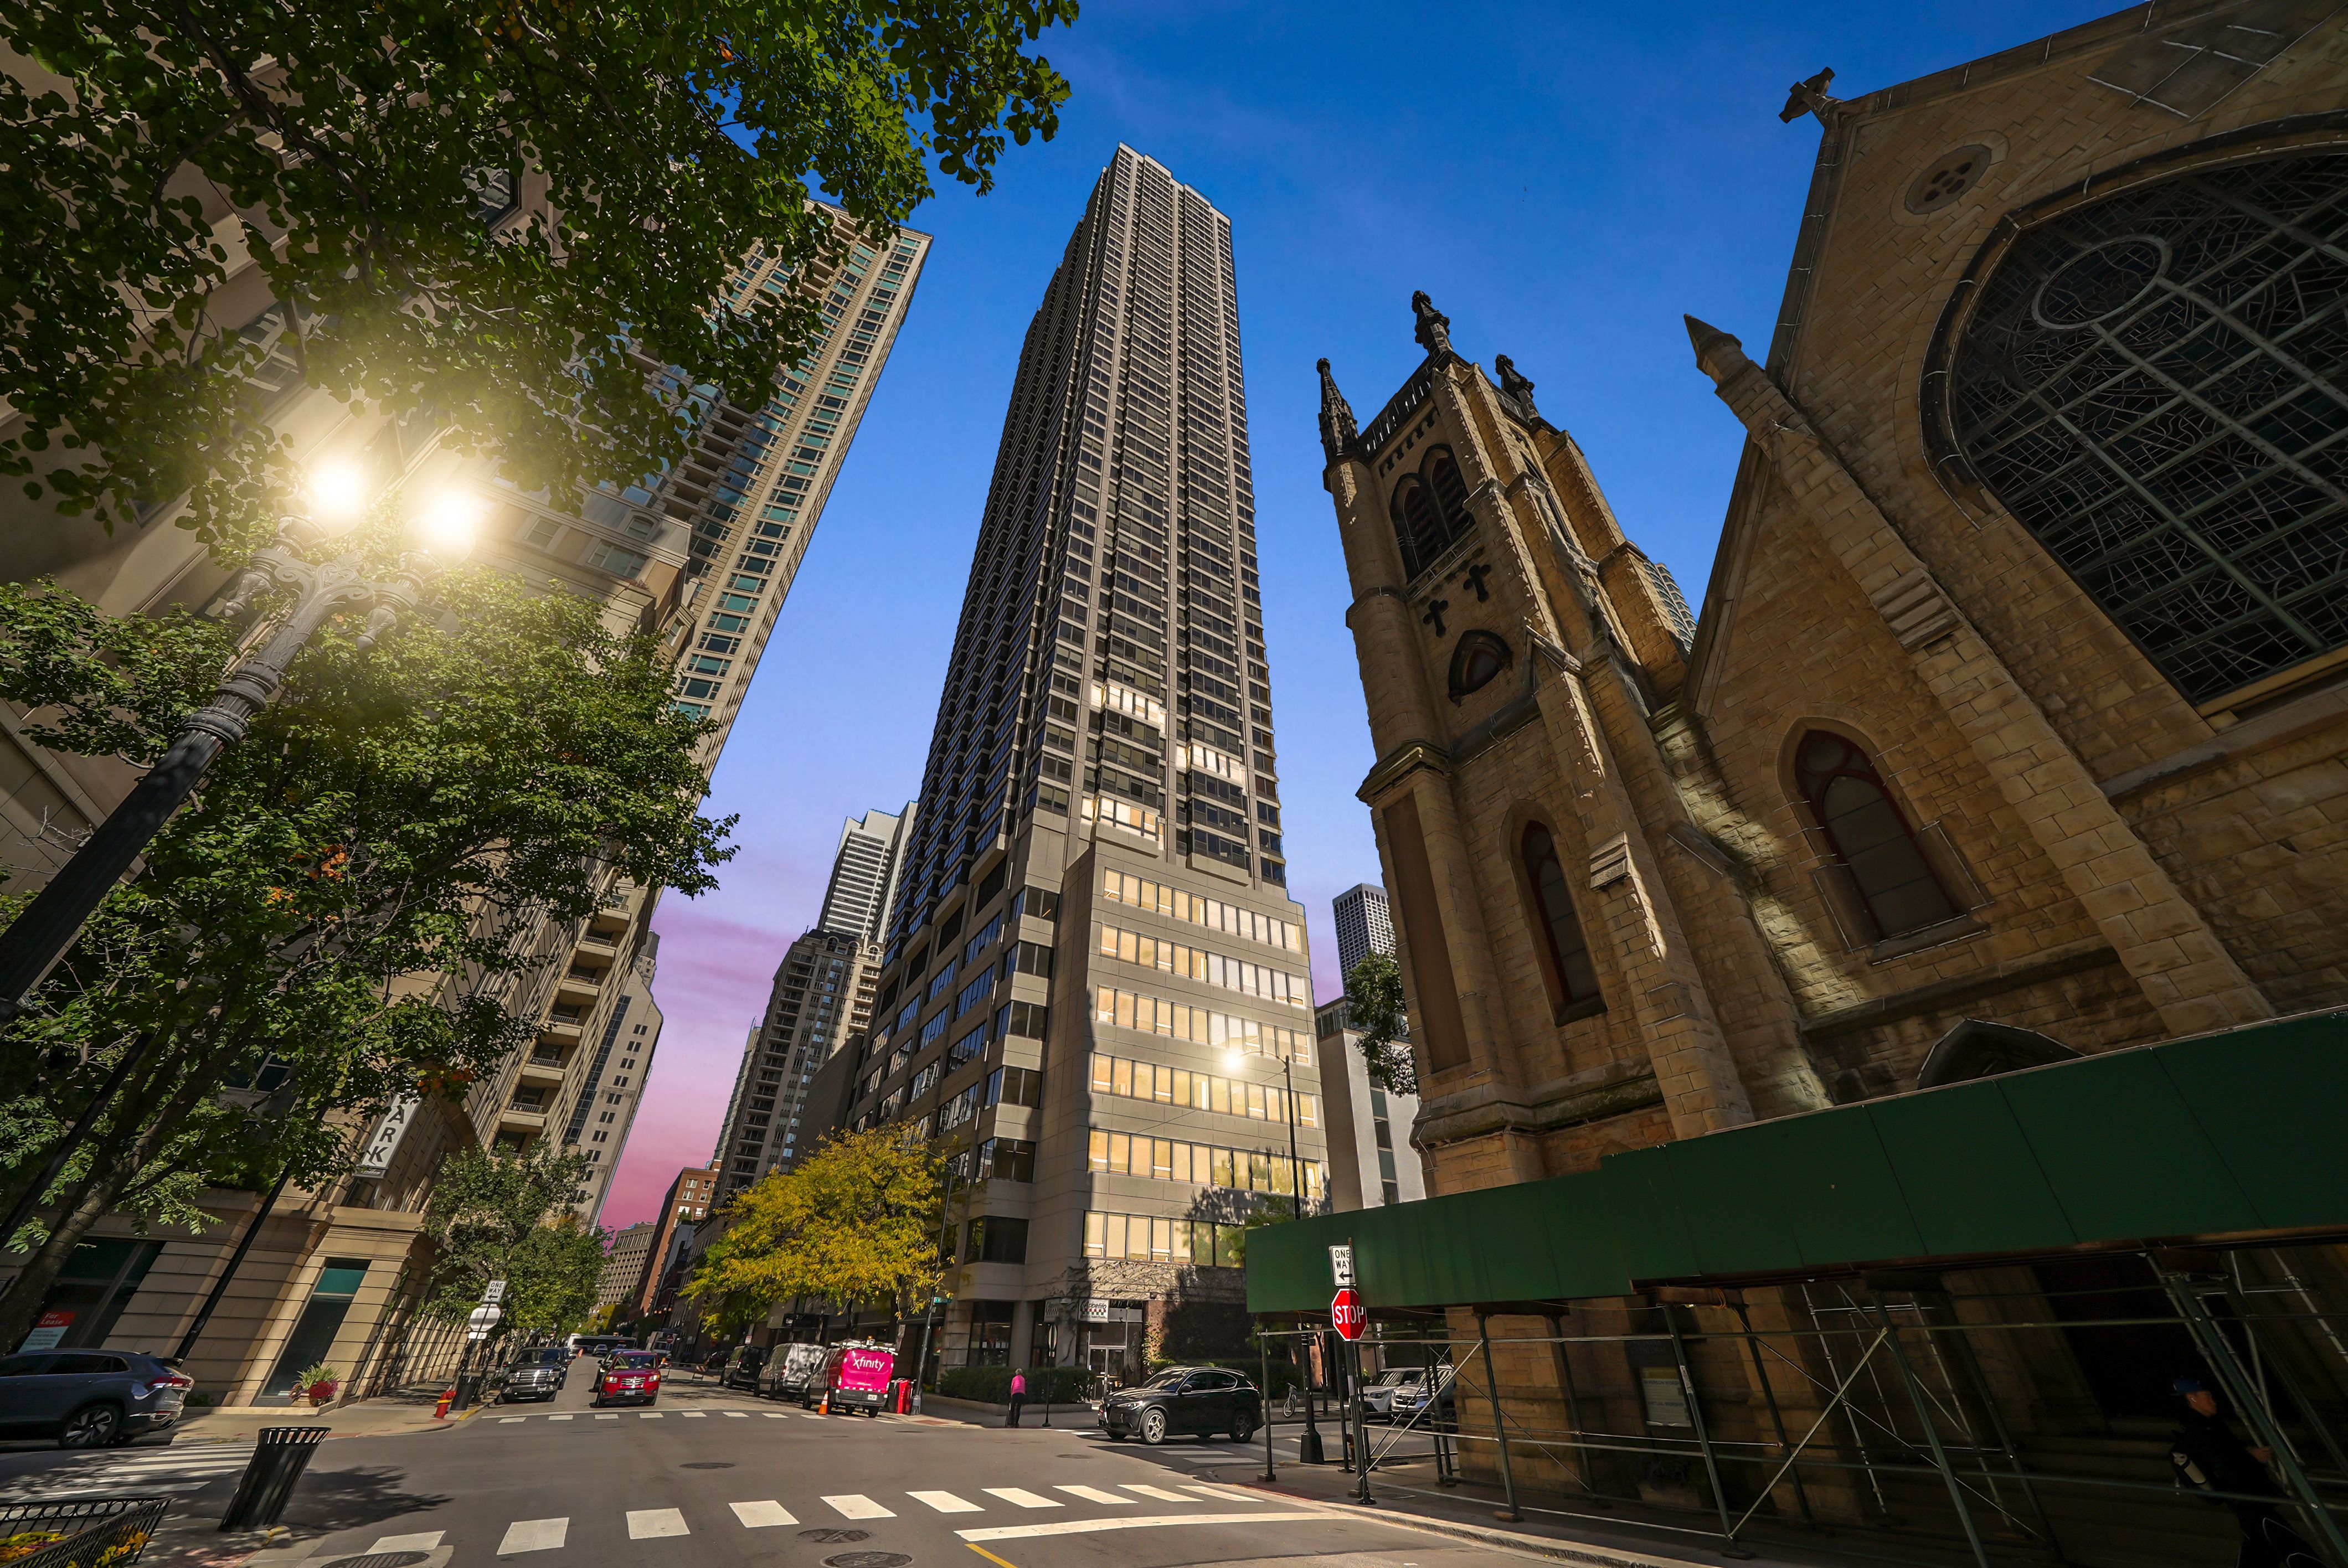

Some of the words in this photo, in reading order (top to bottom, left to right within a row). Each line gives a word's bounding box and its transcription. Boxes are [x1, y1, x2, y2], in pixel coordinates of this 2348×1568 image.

[368, 1091, 414, 1162] ARK
[1335, 1250, 1351, 1258] ONE
[1335, 1260, 1352, 1269] WAY
[1335, 1305, 1364, 1324] STOP
[853, 1356, 885, 1372] xfinity
